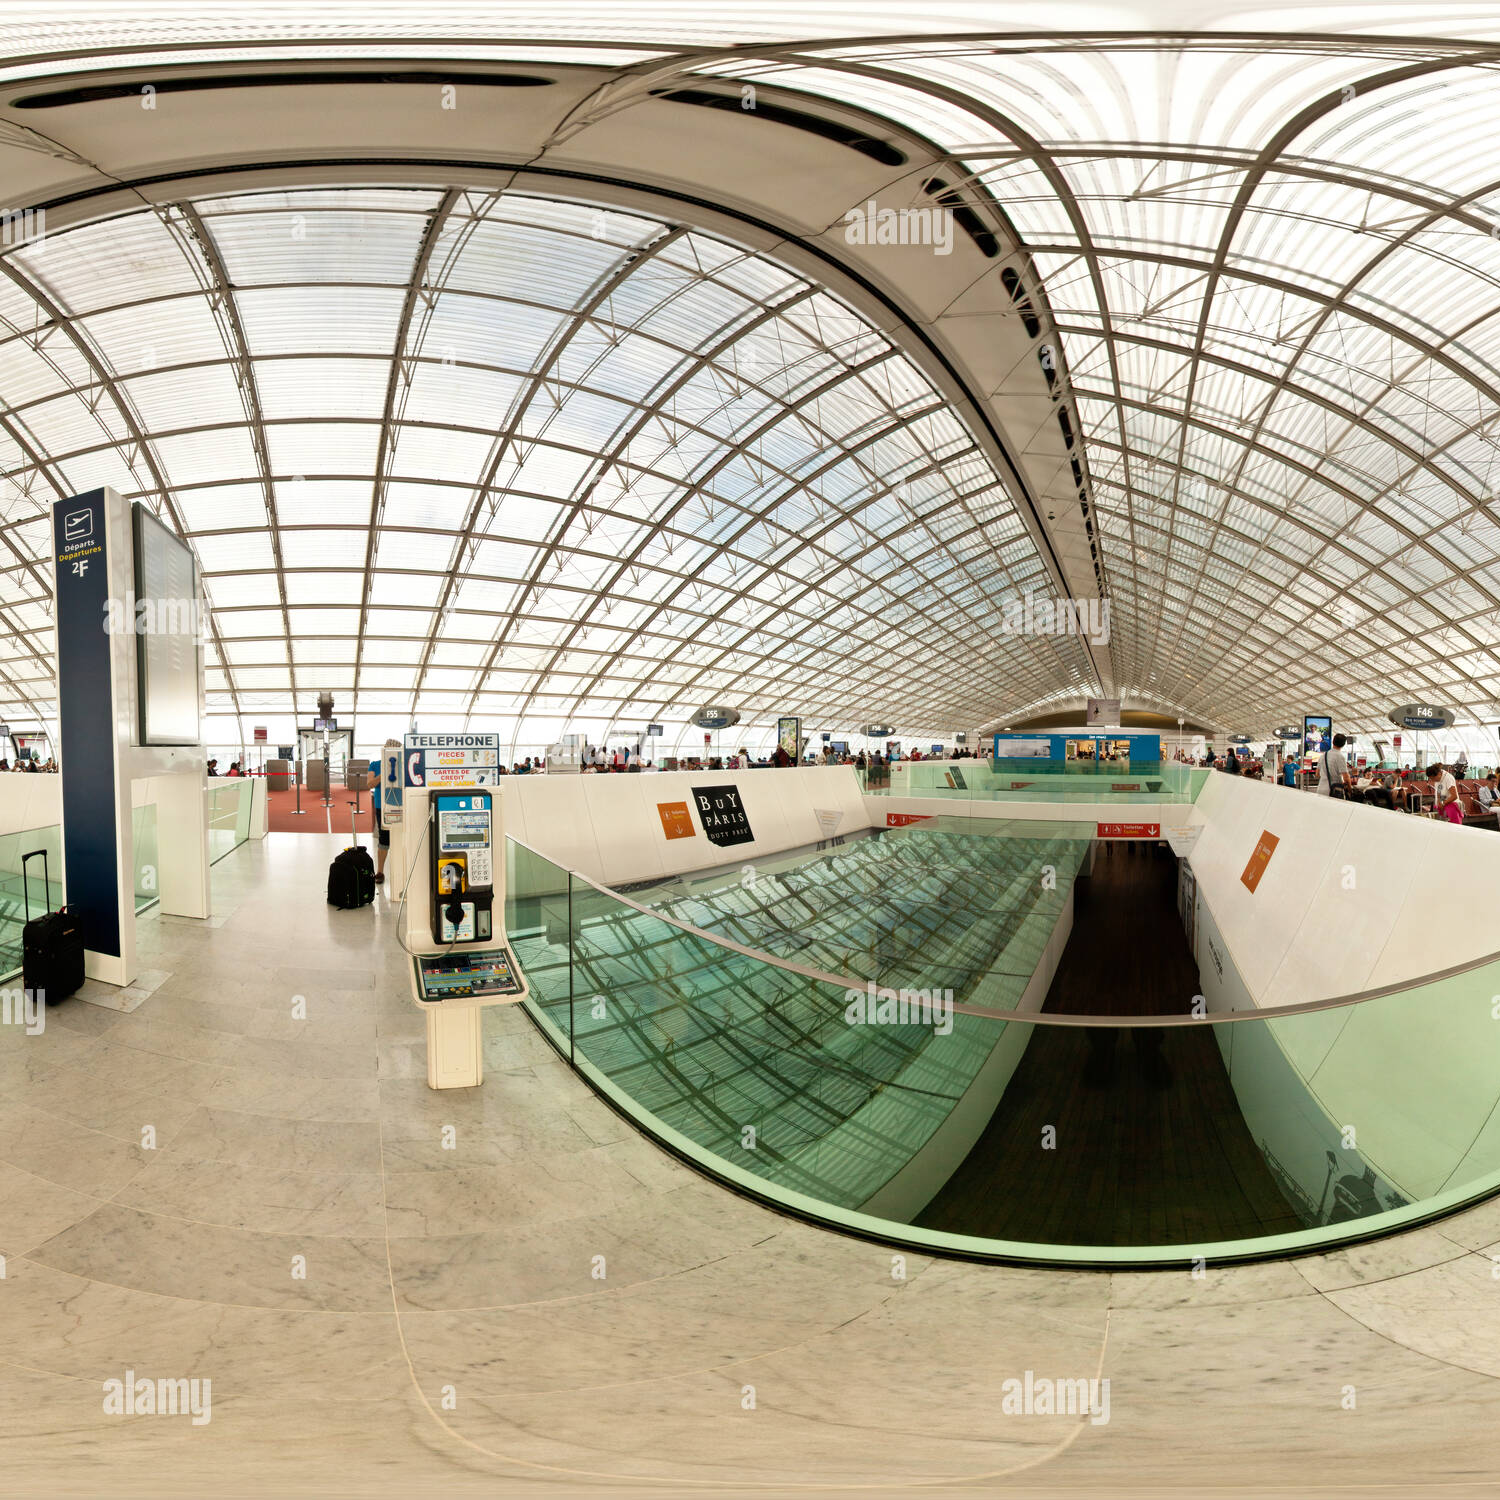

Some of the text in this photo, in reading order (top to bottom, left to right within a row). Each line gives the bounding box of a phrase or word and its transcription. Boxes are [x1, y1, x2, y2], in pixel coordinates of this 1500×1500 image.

[64, 540, 95, 552] Départs
[58, 546, 102, 562] Departures
[72, 560, 88, 577] 2F
[706, 710, 718, 718] F55
[1417, 708, 1433, 717] F46
[411, 736, 493, 746] TELEPHONE
[706, 811, 744, 827] PARIS
